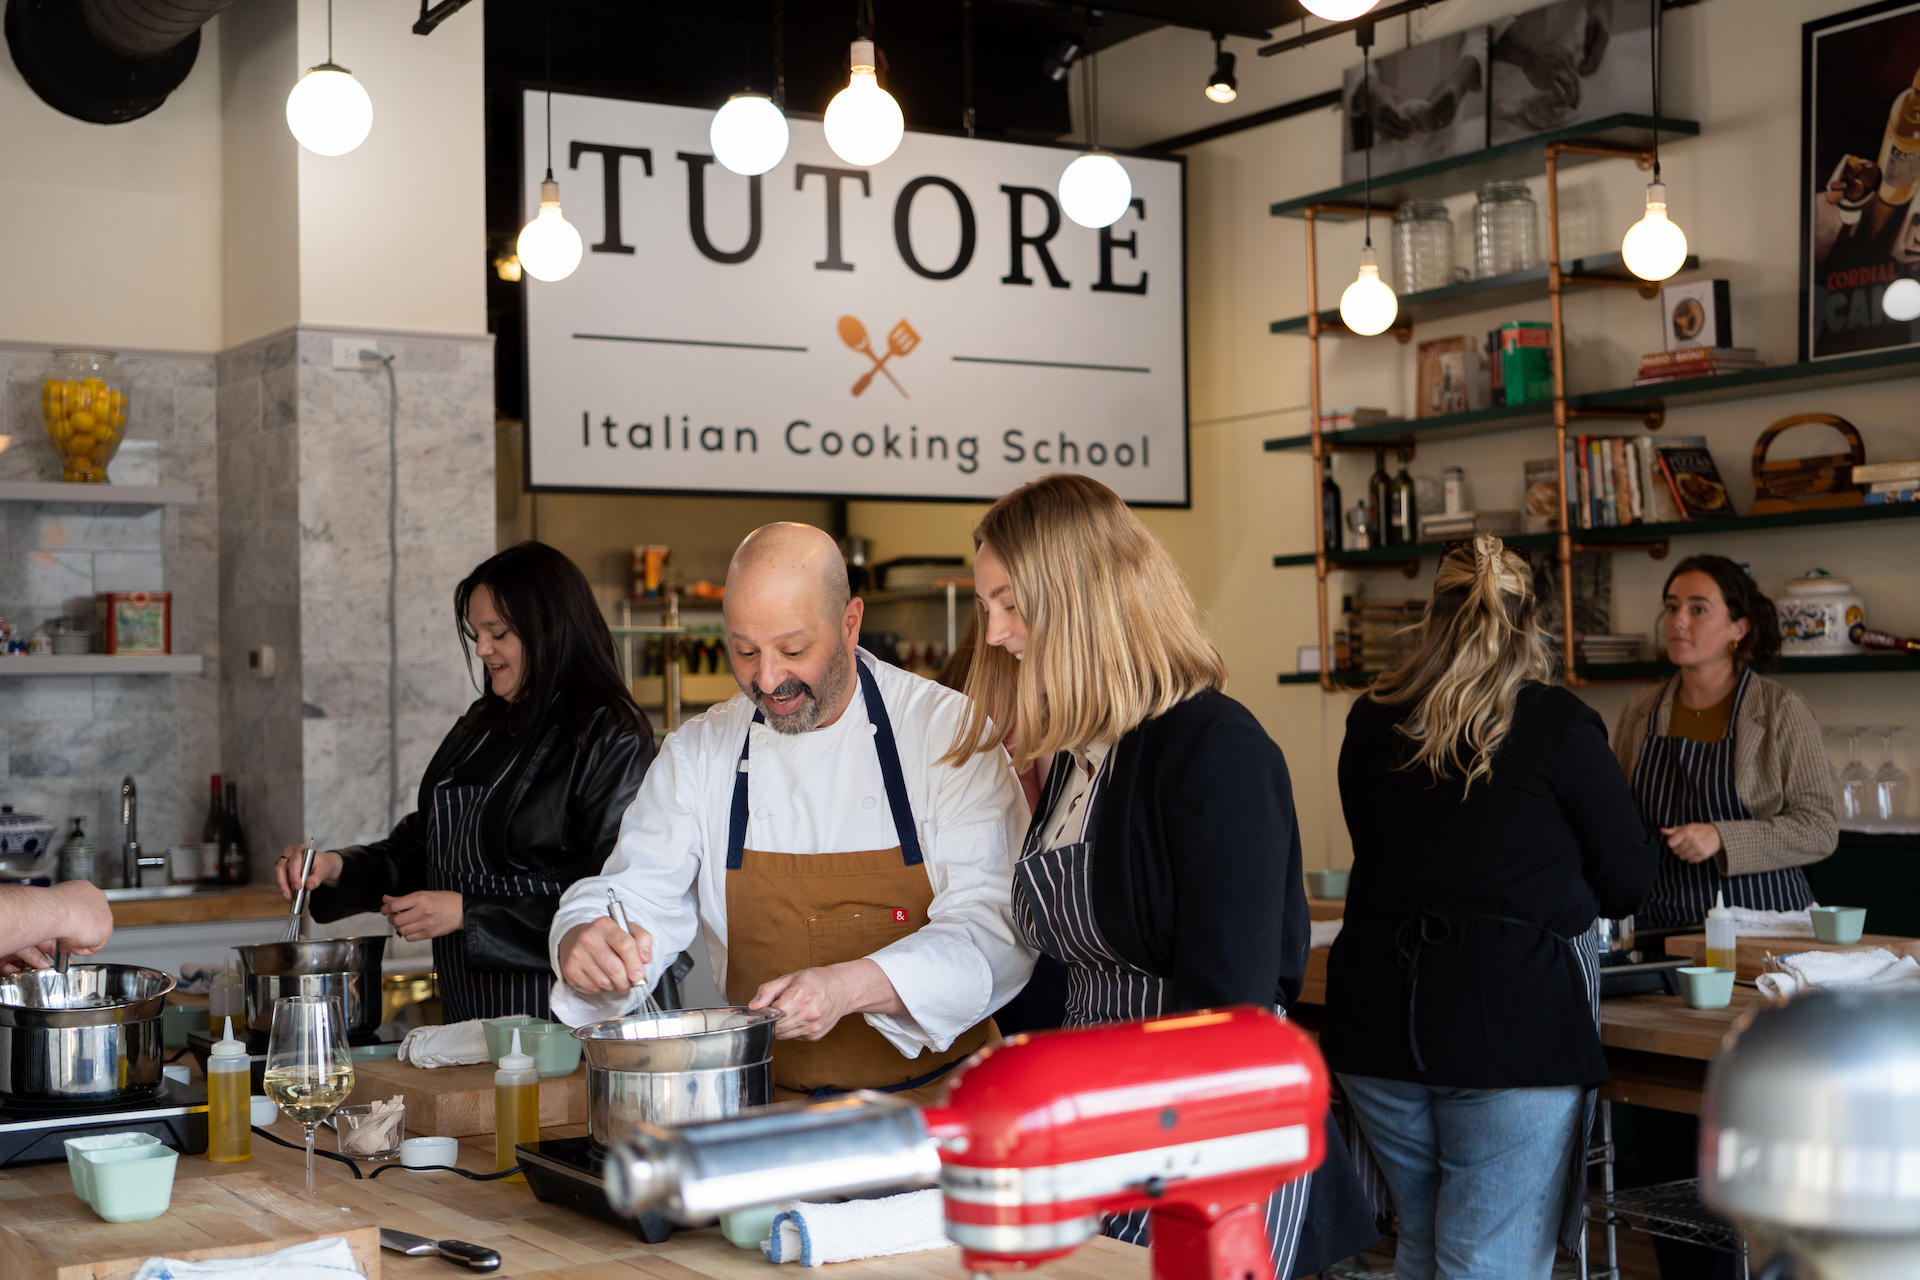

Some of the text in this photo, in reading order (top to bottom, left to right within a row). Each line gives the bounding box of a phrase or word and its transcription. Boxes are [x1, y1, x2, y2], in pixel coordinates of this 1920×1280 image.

[568, 140, 1149, 296] TUTORE
[1827, 262, 1897, 291] CORDIAL
[583, 411, 1148, 474] Italian Cooking School
[896, 910, 905, 921] &
